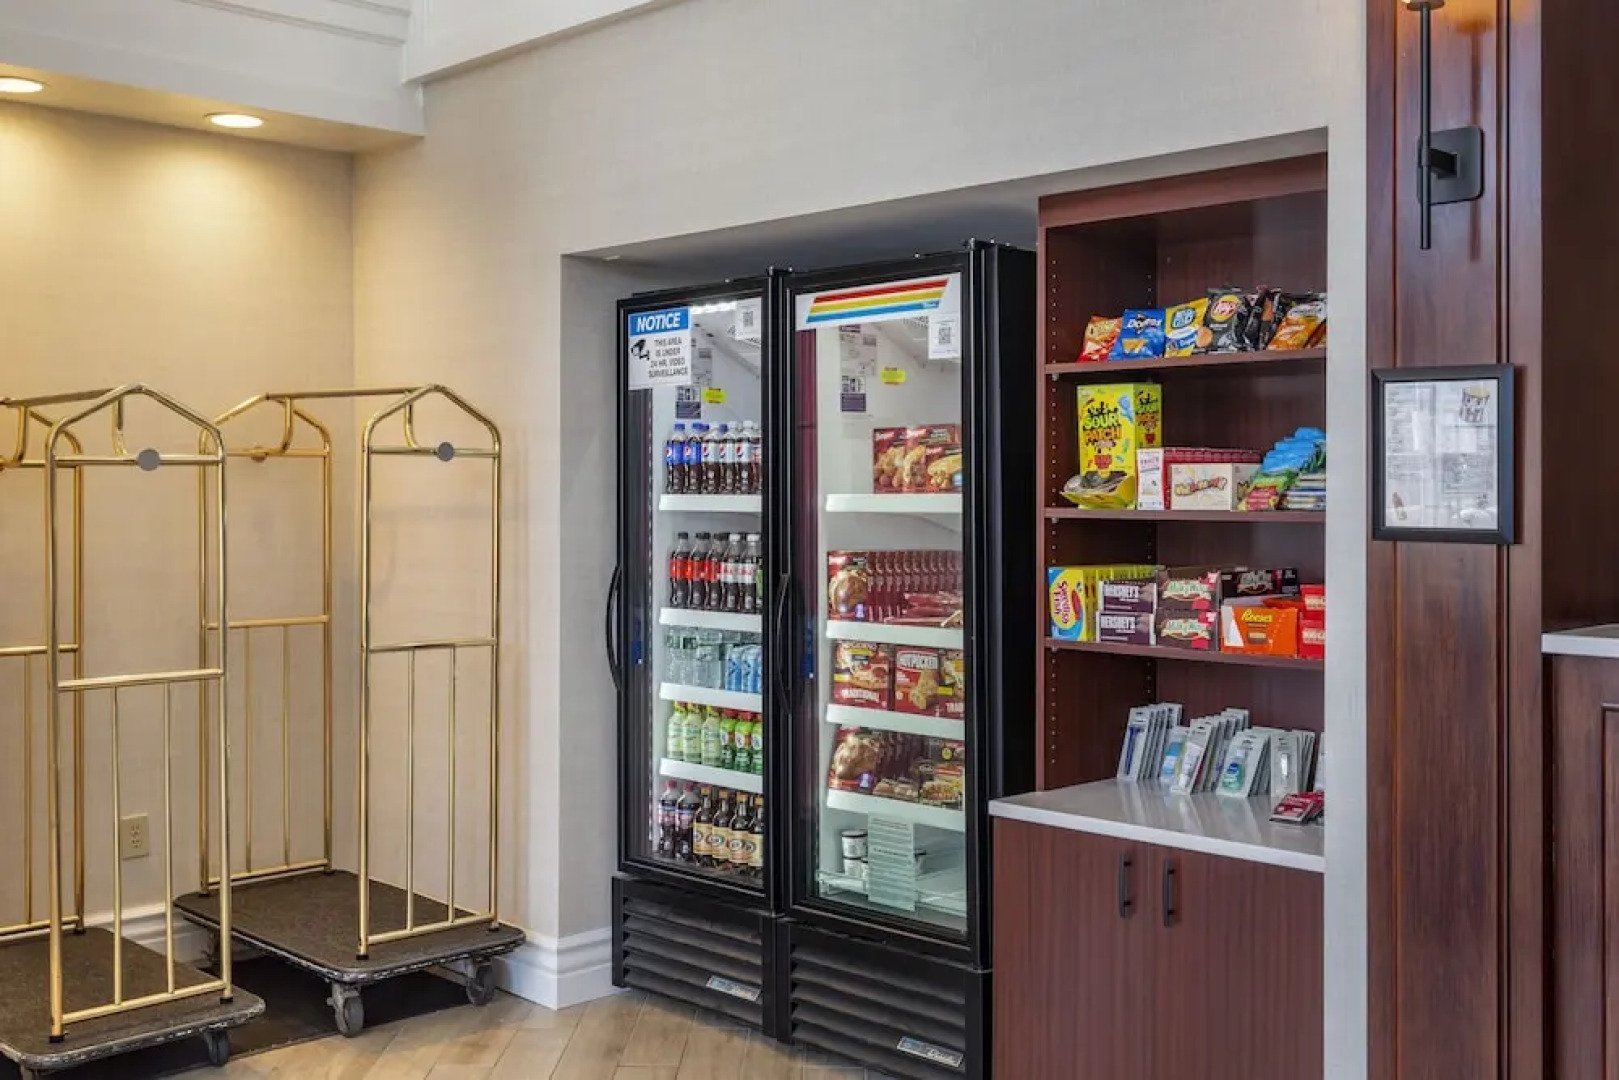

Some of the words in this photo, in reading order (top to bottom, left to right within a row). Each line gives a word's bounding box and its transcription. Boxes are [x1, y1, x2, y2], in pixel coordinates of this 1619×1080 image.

[636, 312, 681, 333] NOTICE
[654, 339, 666, 347] THIS
[668, 336, 682, 346] AREA
[662, 347, 681, 356] UNDER
[650, 360, 658, 368] 24
[669, 357, 686, 367] VIDEO
[1083, 412, 1120, 430] SOUR
